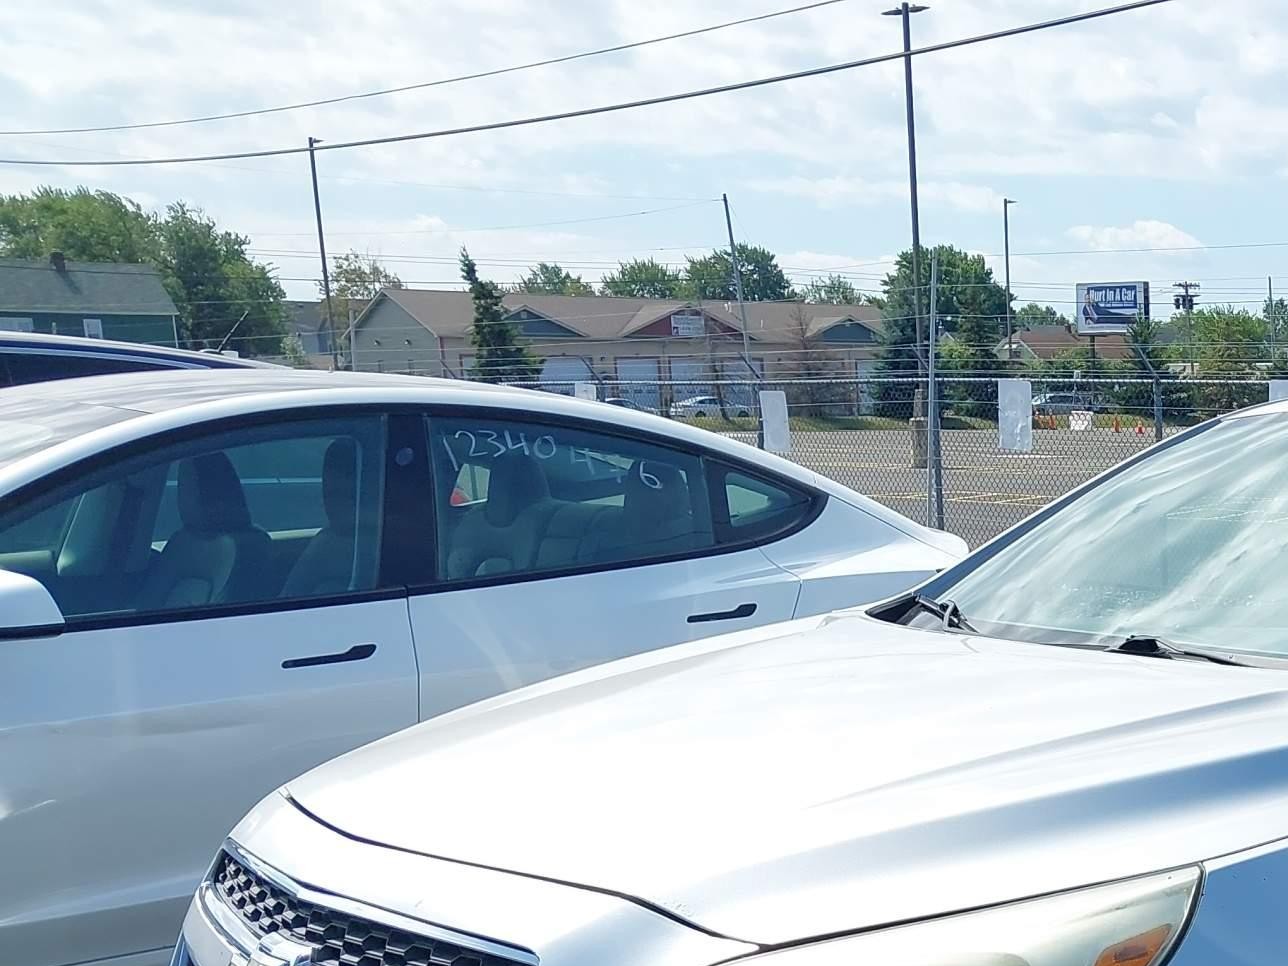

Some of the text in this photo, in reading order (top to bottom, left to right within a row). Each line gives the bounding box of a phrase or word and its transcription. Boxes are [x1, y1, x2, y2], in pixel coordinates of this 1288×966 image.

[1090, 287, 1136, 302] Hurt In A Car
